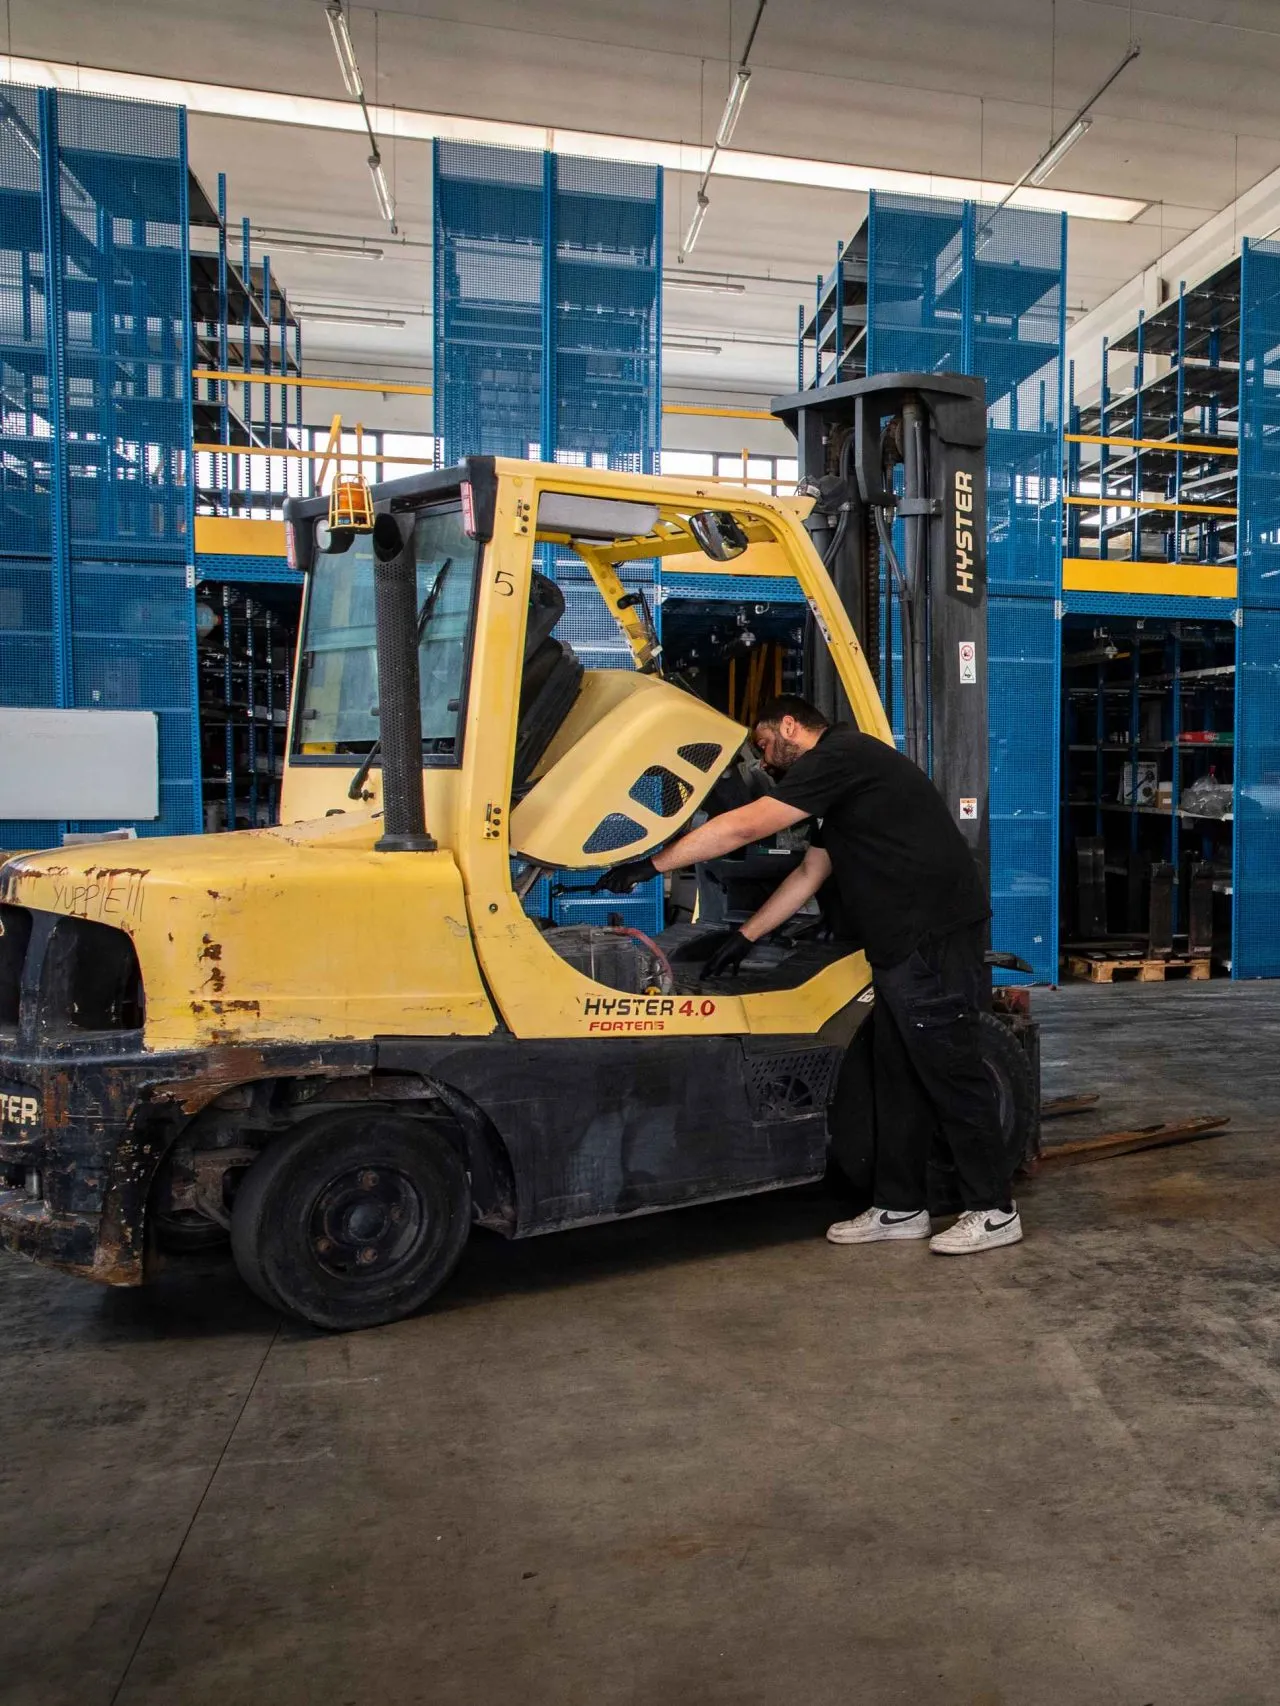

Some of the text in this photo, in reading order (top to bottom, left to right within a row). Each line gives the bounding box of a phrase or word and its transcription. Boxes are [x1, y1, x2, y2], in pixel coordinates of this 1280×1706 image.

[955, 471, 974, 593] HYSTER
[494, 571, 514, 596] 5
[584, 998, 716, 1017] HYSTER 4.0
[589, 1020, 665, 1031] FORTENS
